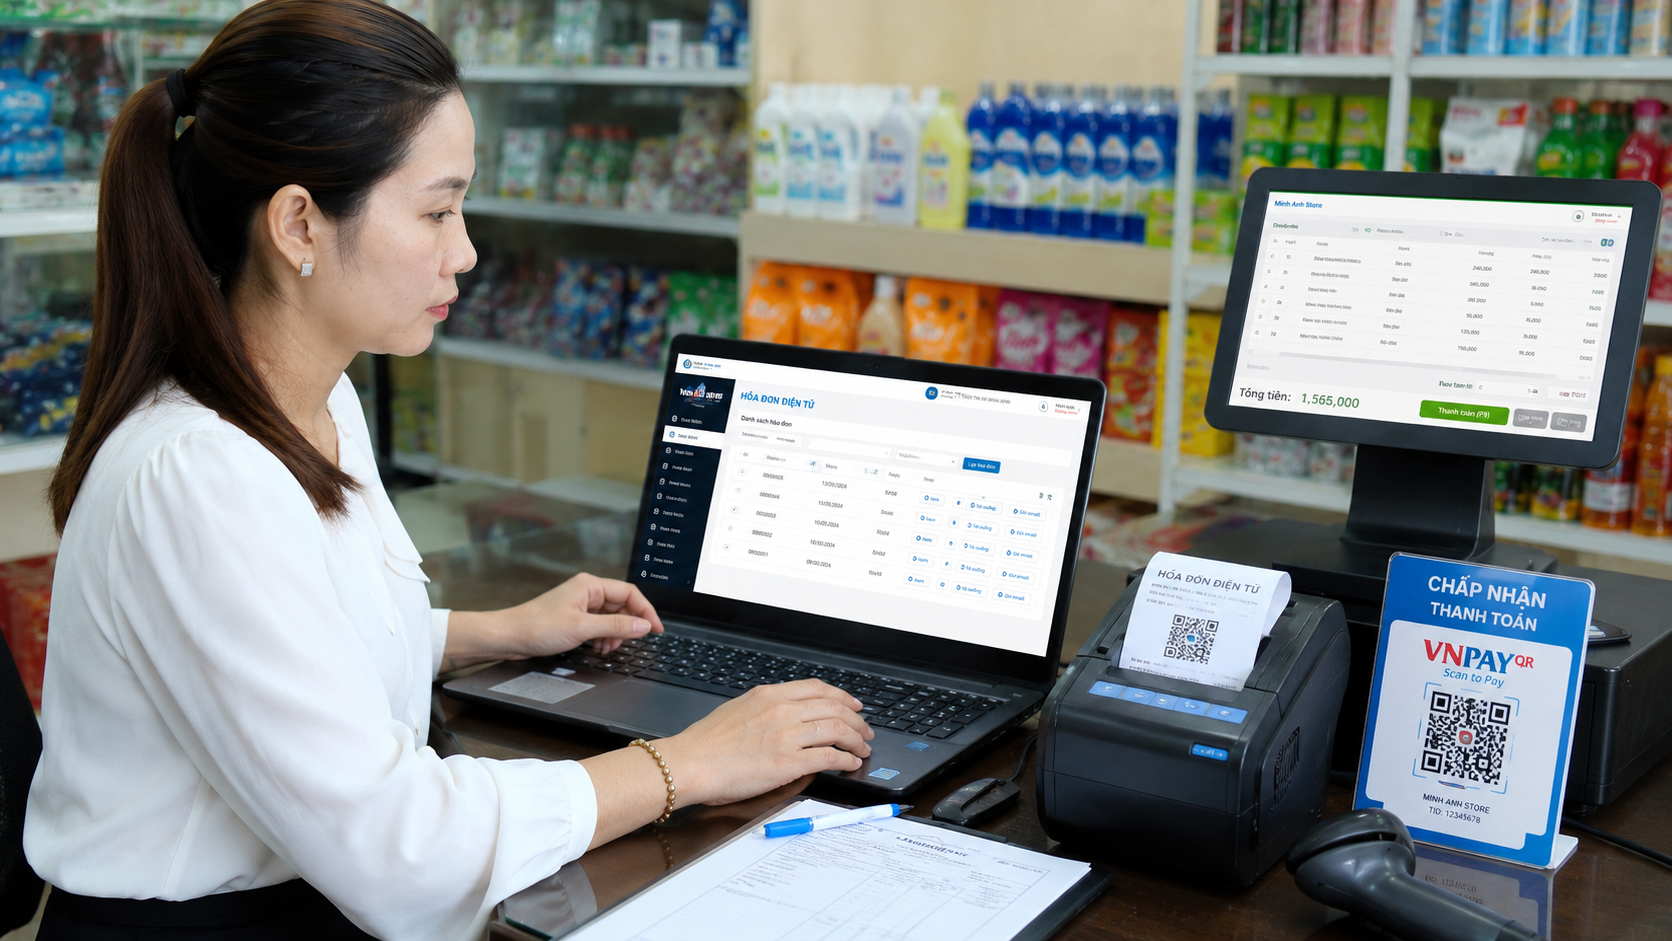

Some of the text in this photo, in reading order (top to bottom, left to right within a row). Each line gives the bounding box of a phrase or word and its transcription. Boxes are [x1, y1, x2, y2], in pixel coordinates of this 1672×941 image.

[1274, 200, 1291, 208] Minh
[1301, 393, 1360, 409] 1,565,000
[1157, 569, 1182, 581] HÓA
[1428, 575, 1547, 610] CHẤP NHẬN
[1430, 602, 1538, 632] THANH TOÁN
[1443, 667, 1505, 689] Scan to Pay
[1422, 793, 1491, 814] MINH ANH STORE
[1428, 806, 1481, 824] TID: 12345678
